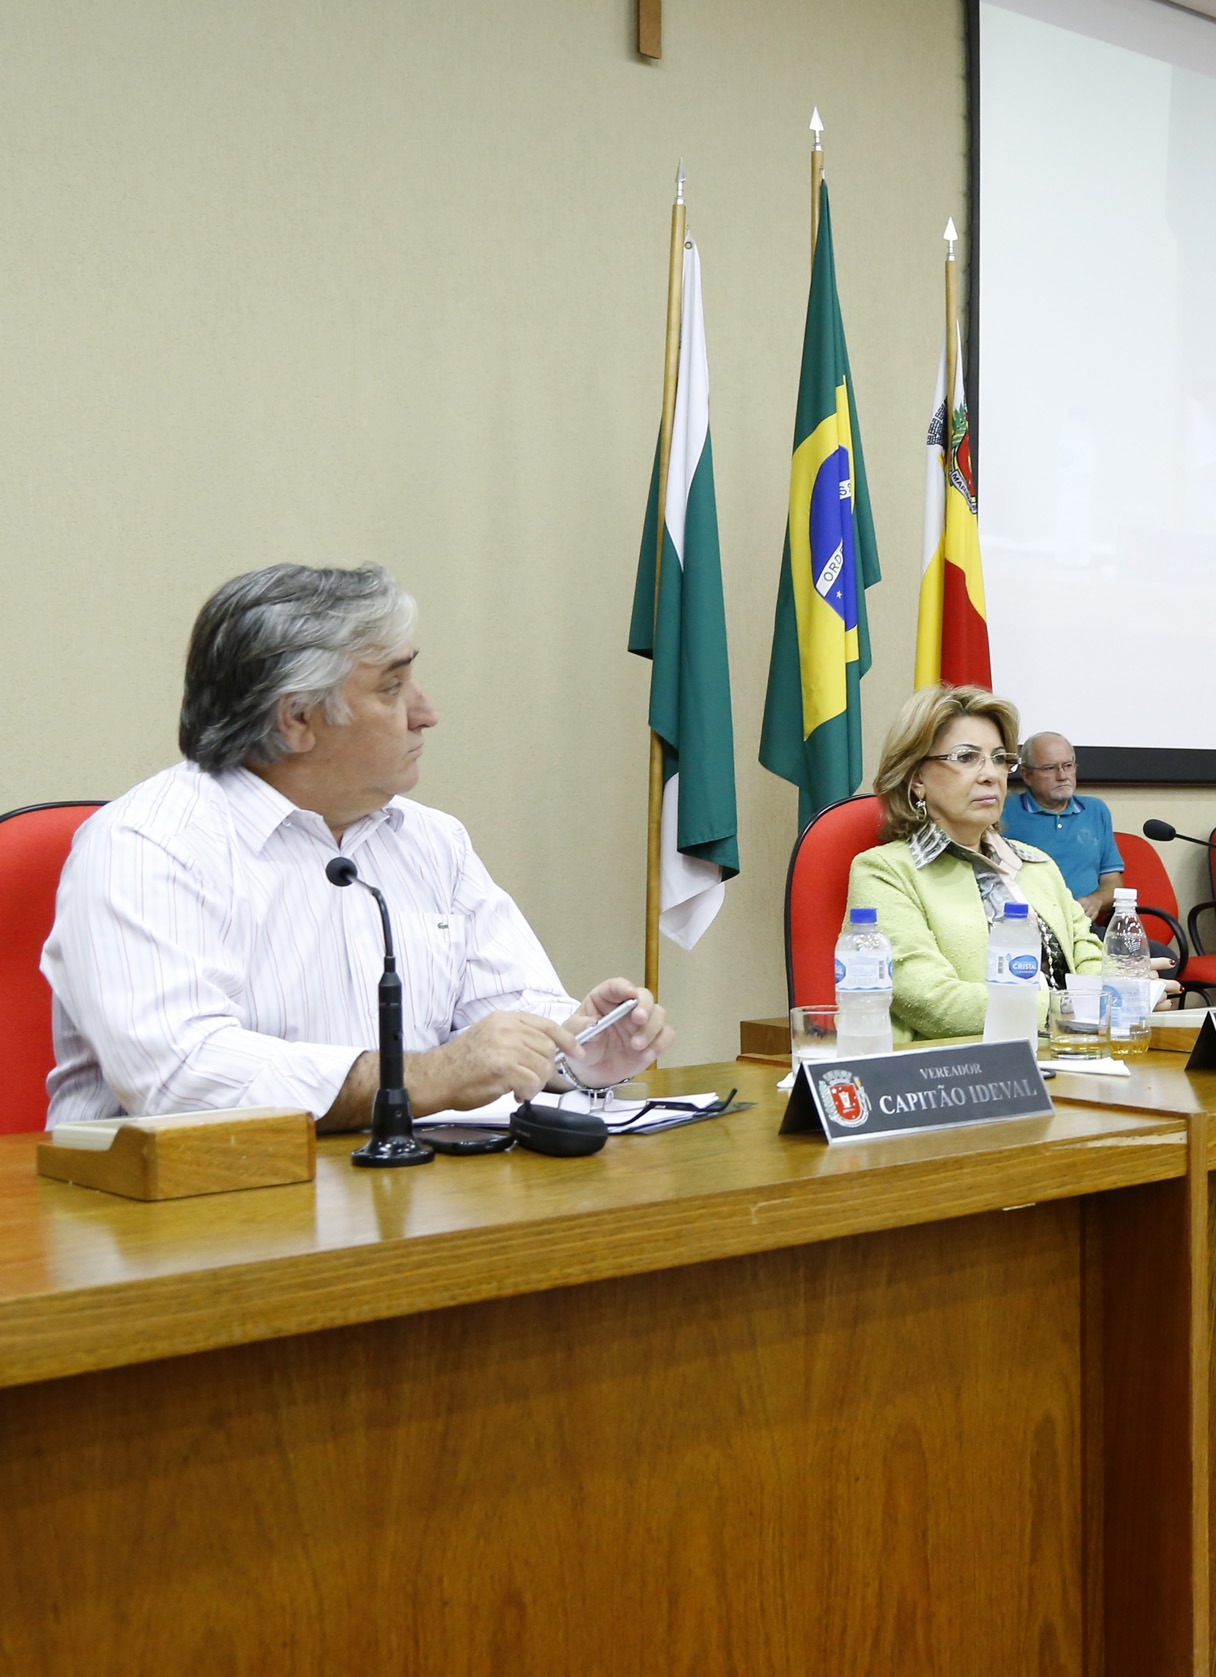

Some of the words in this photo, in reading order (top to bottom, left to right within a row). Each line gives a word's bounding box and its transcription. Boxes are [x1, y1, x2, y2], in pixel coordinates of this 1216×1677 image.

[919, 1062, 983, 1080] VEREADOR
[879, 1084, 967, 1115] CAPITÃO
[968, 1079, 1038, 1104] IDEVAL
